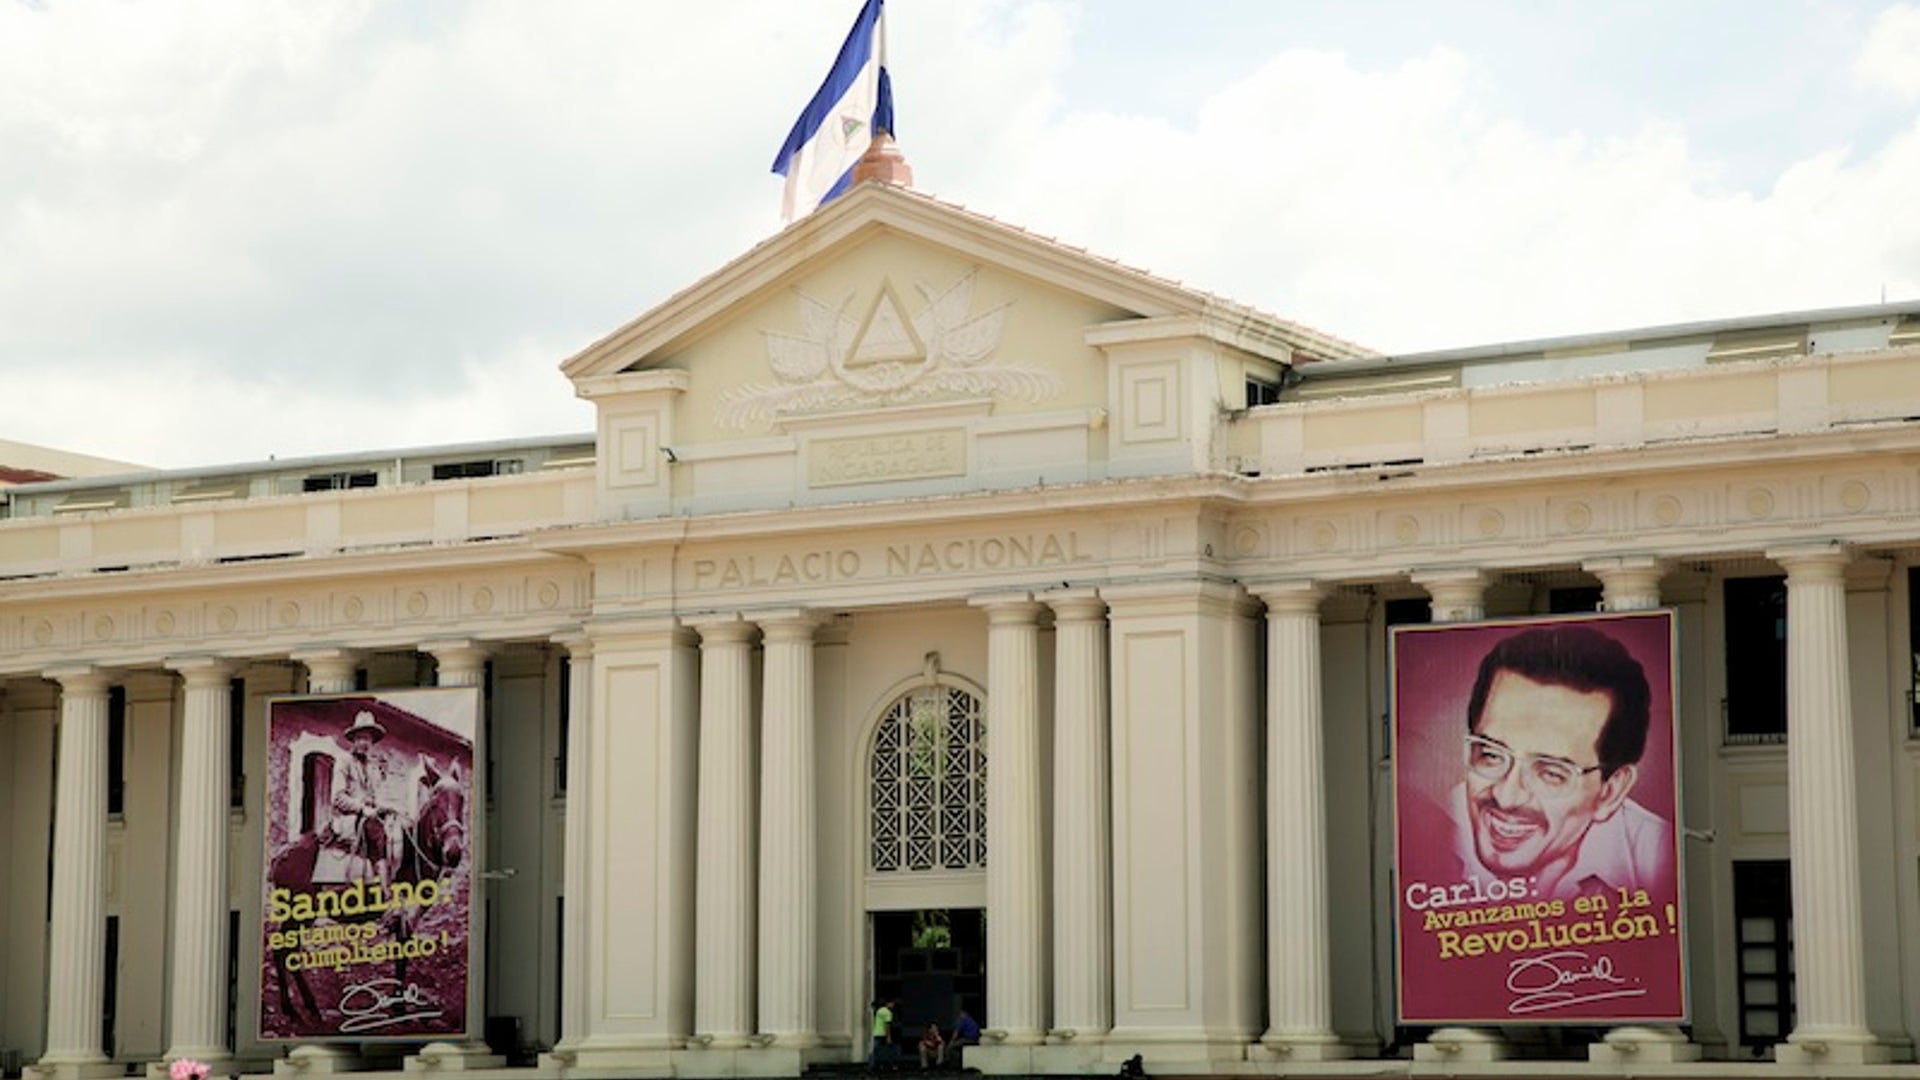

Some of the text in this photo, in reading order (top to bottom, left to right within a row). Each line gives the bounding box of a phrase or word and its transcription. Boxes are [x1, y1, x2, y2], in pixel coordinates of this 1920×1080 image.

[693, 531, 1093, 591] PALACIO NACIONAL
[268, 876, 453, 923] Sandino:
[1405, 876, 1539, 910] Carlos:
[1423, 887, 1651, 931] Avanzamos en la
[268, 921, 377, 950] estamos
[285, 930, 449, 972] cumpliendo!
[1437, 904, 1676, 959] Revolución!
